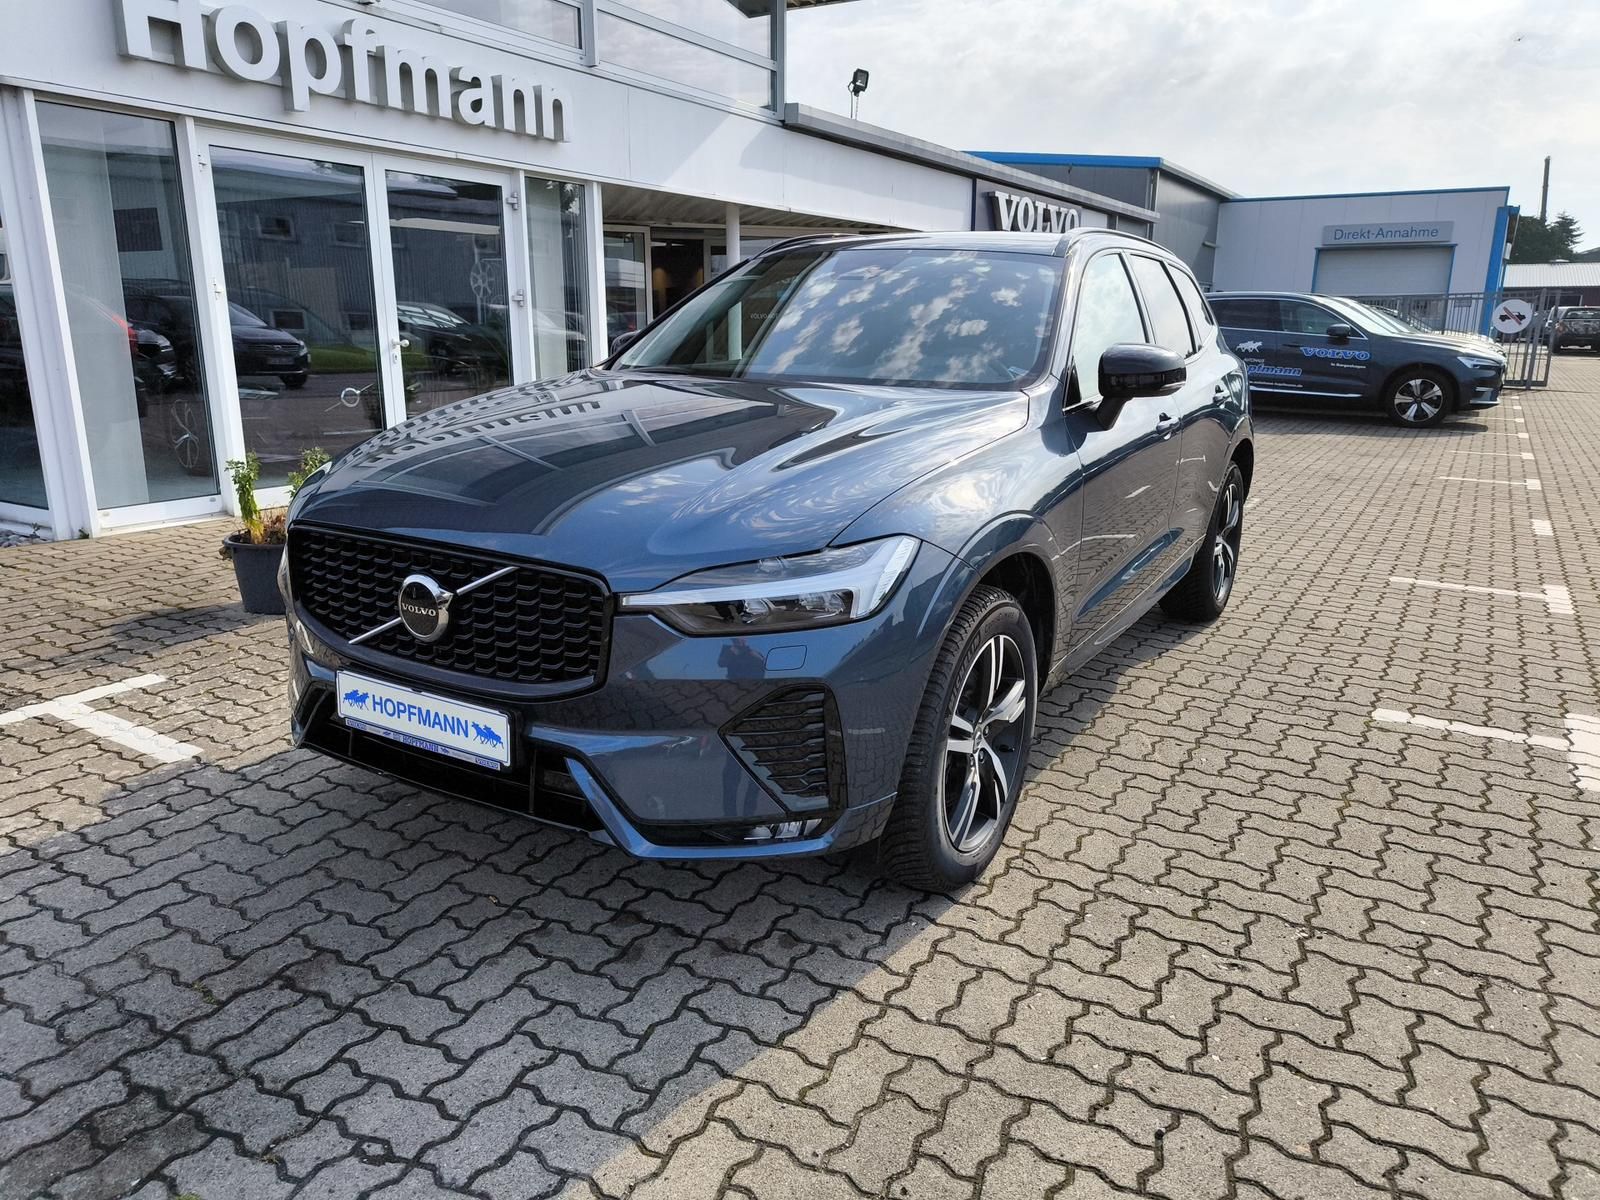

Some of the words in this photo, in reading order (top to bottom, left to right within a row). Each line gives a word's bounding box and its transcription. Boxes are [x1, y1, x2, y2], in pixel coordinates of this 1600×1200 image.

[119, 0, 572, 142] Hopfmann
[994, 190, 1080, 233] VOLVO
[1334, 226, 1439, 240] Direkt-Annahme
[1301, 347, 1370, 360] VOLVO
[401, 602, 437, 617] VOLVO
[371, 694, 469, 738] HOPFMANN
